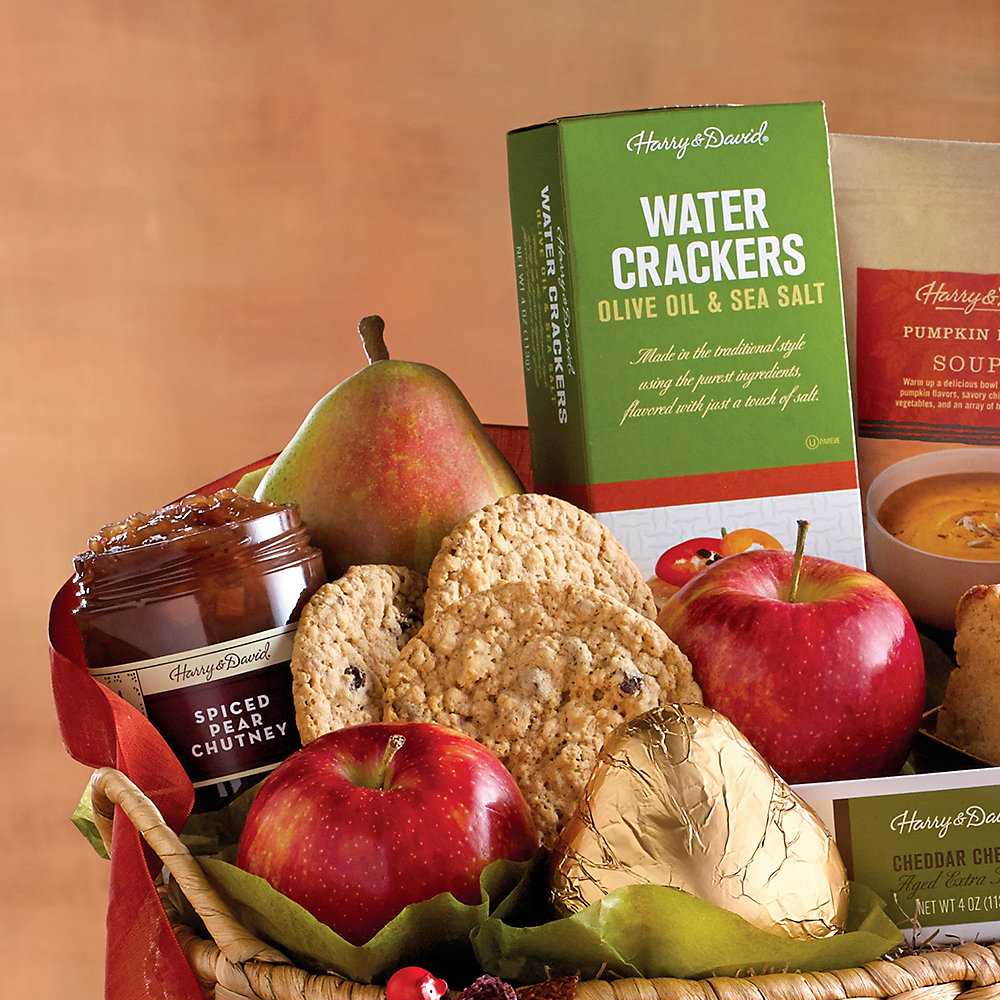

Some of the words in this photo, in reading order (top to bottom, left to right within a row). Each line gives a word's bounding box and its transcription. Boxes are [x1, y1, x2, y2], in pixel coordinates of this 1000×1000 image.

[640, 188, 769, 238] WATER
[611, 233, 806, 290] CRACKERS
[541, 185, 556, 276] WATER
[549, 286, 568, 424] CRACKERS
[597, 296, 658, 323] OLIVE
[666, 293, 699, 317] OIL
[707, 291, 722, 313] &
[731, 287, 769, 312] SEA
[777, 282, 825, 308] SALT
[903, 326, 989, 341] PUMPKIN
[629, 344, 675, 365] Made
[677, 348, 690, 361] in
[692, 341, 711, 359] the
[713, 335, 781, 358] traditional
[777, 333, 806, 359] style
[638, 376, 673, 396] using
[675, 369, 694, 388] the
[691, 370, 735, 393] purest
[736, 361, 802, 389] ingredients,
[903, 377, 924, 386] Warm
[925, 380, 935, 388] up
[943, 379, 978, 388] delicious
[980, 380, 998, 389] bowl
[619, 397, 679, 426] flavored
[675, 394, 704, 414] with
[701, 397, 731, 419] just
[732, 399, 741, 409] a
[744, 388, 776, 408] touch
[779, 384, 799, 412] of
[793, 384, 820, 403] salt.
[894, 399, 936, 409] vegetables,
[937, 400, 952, 408] and
[964, 402, 985, 411] array
[986, 402, 994, 410] of
[900, 389, 931, 398] pumpkin
[932, 389, 960, 399] flavors,
[961, 391, 986, 401] savory
[193, 694, 271, 724] SPICED
[191, 721, 288, 758] CHUTNEY
[208, 712, 263, 738] PEAR
[893, 848, 966, 872] CHEDDAR
[890, 870, 943, 900] Aged
[945, 871, 986, 889] Extra
[918, 900, 936, 915] NET
[938, 898, 956, 913] WT
[958, 899, 965, 911] 4
[967, 896, 981, 911] OZ
